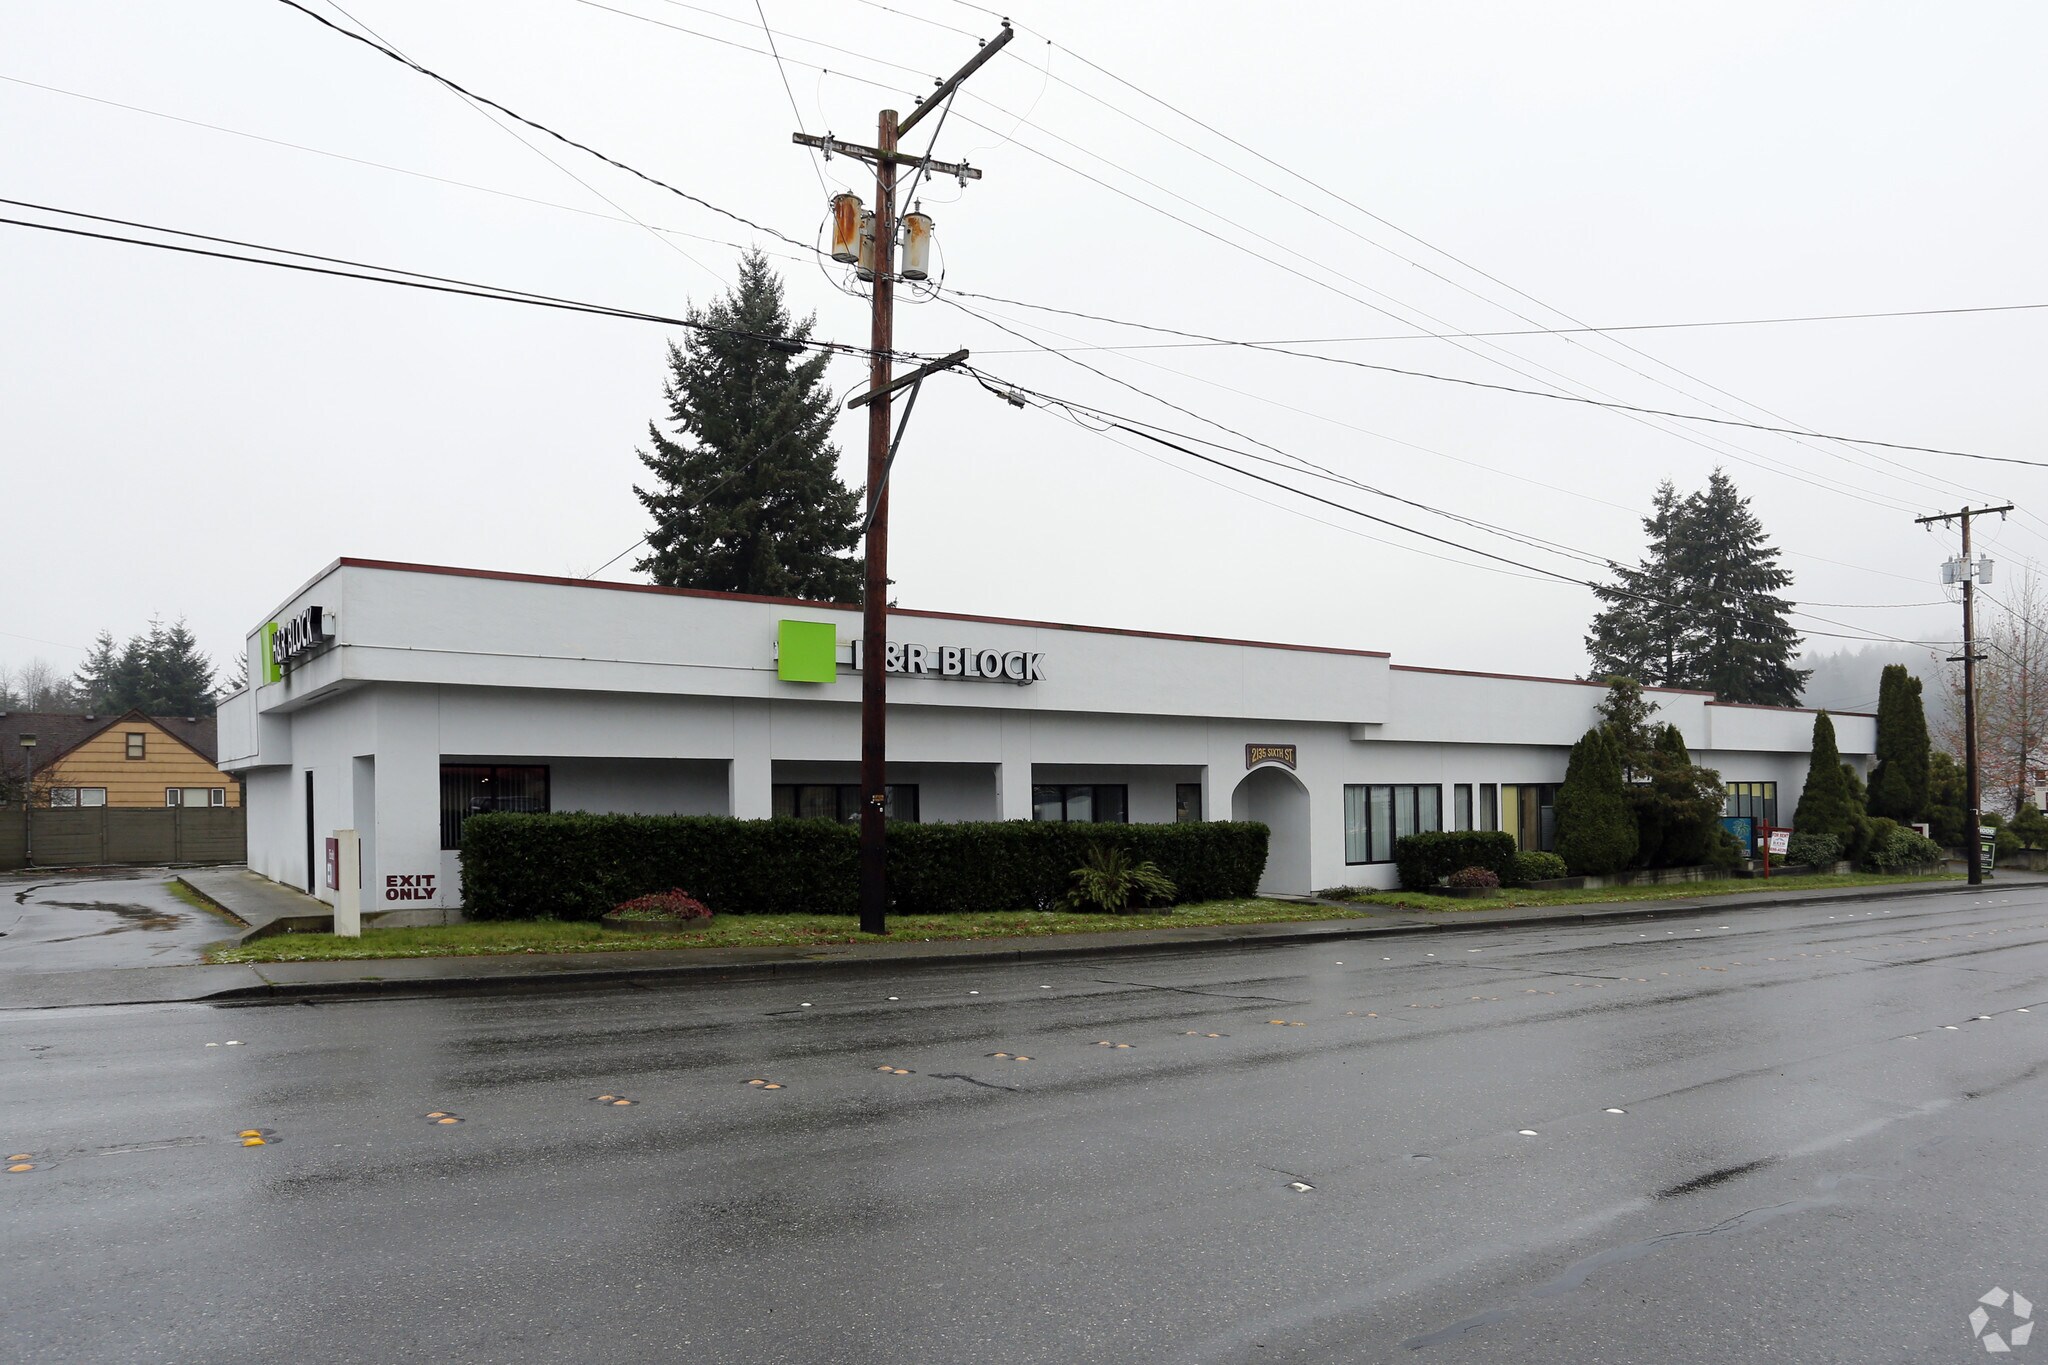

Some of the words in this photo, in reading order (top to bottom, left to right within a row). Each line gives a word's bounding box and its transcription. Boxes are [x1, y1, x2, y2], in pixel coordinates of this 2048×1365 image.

[288, 607, 315, 656] BLOCK
[939, 646, 1046, 681] BLOCK
[1251, 747, 1267, 763] 2135
[1267, 748, 1284, 759] SIXTH
[386, 874, 435, 888] EXIT
[385, 887, 437, 901] ONLY
